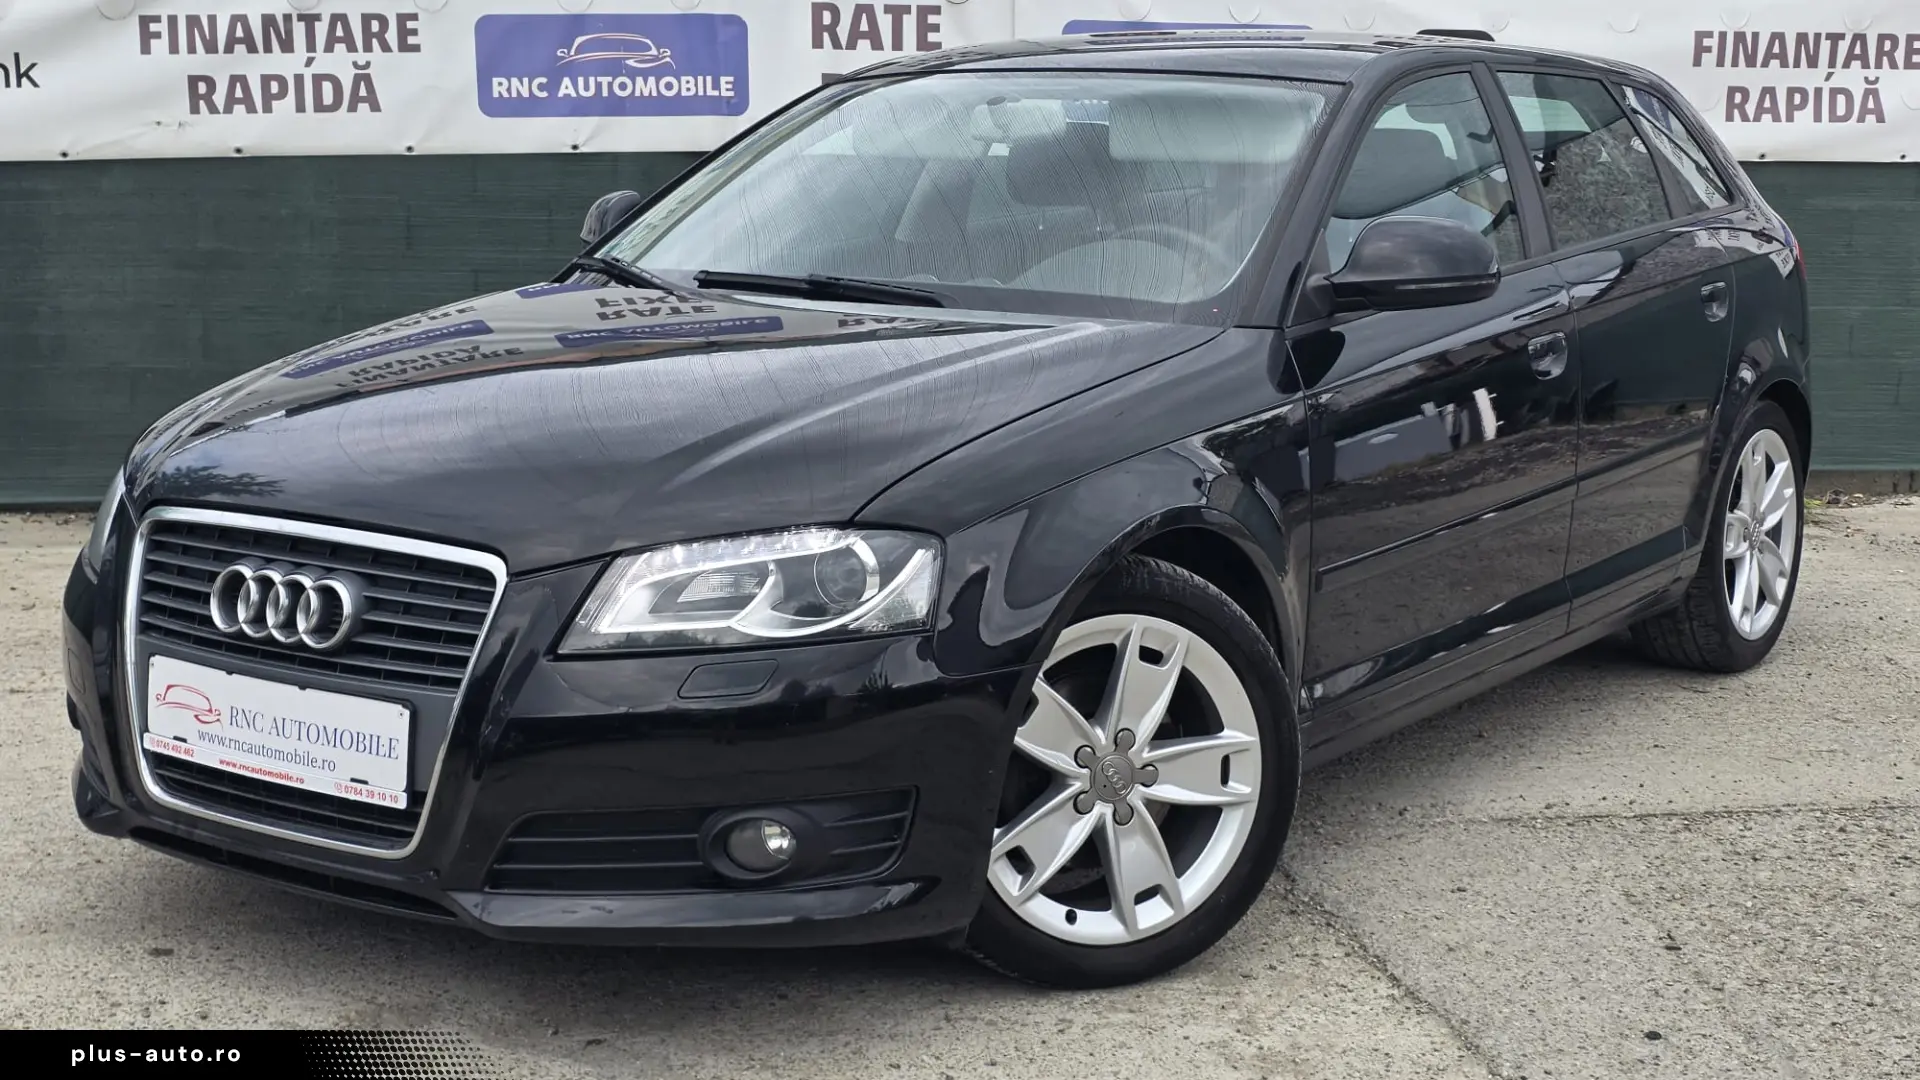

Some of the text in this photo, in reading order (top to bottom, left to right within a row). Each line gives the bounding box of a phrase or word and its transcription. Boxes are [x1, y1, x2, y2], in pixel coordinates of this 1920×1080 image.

[811, 2, 943, 52] RATE
[492, 76, 735, 98] RNC AUTOMOBILE
[229, 705, 400, 760] RNC AUTOMOBILE
[198, 729, 337, 772] www.rncautomobile.ro
[219, 758, 305, 784] www.rncautomobile.ro
[344, 785, 399, 804] 0784 39 10 10
